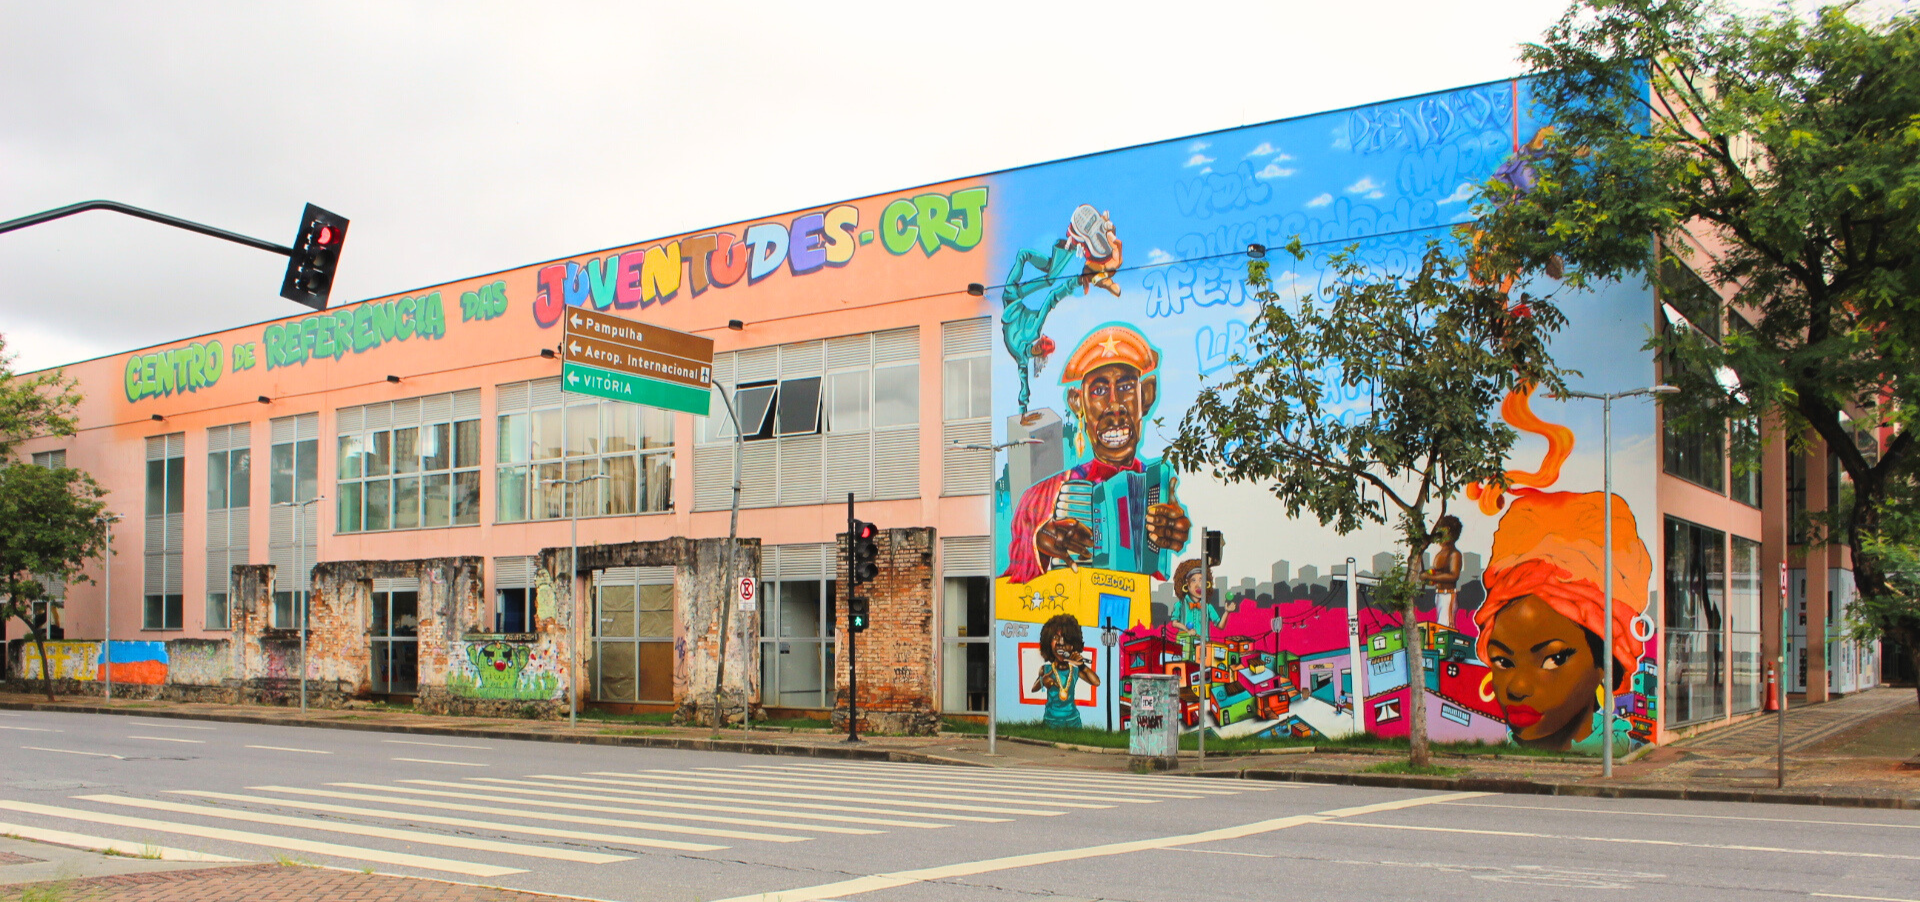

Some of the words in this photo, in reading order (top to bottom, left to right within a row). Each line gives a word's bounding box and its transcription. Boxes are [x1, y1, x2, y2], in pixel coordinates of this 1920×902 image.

[125, 340, 225, 404] CENTRO
[232, 343, 256, 372] DE
[263, 291, 446, 371] REFERÊNCIA
[460, 280, 509, 322] DAS
[533, 205, 858, 328] JUVENTUDES
[880, 186, 989, 257] CRJ
[585, 317, 643, 342] Pampulha
[585, 346, 623, 366] Aerop.
[627, 354, 699, 381] Internacional
[583, 373, 632, 395] VITÓRIA
